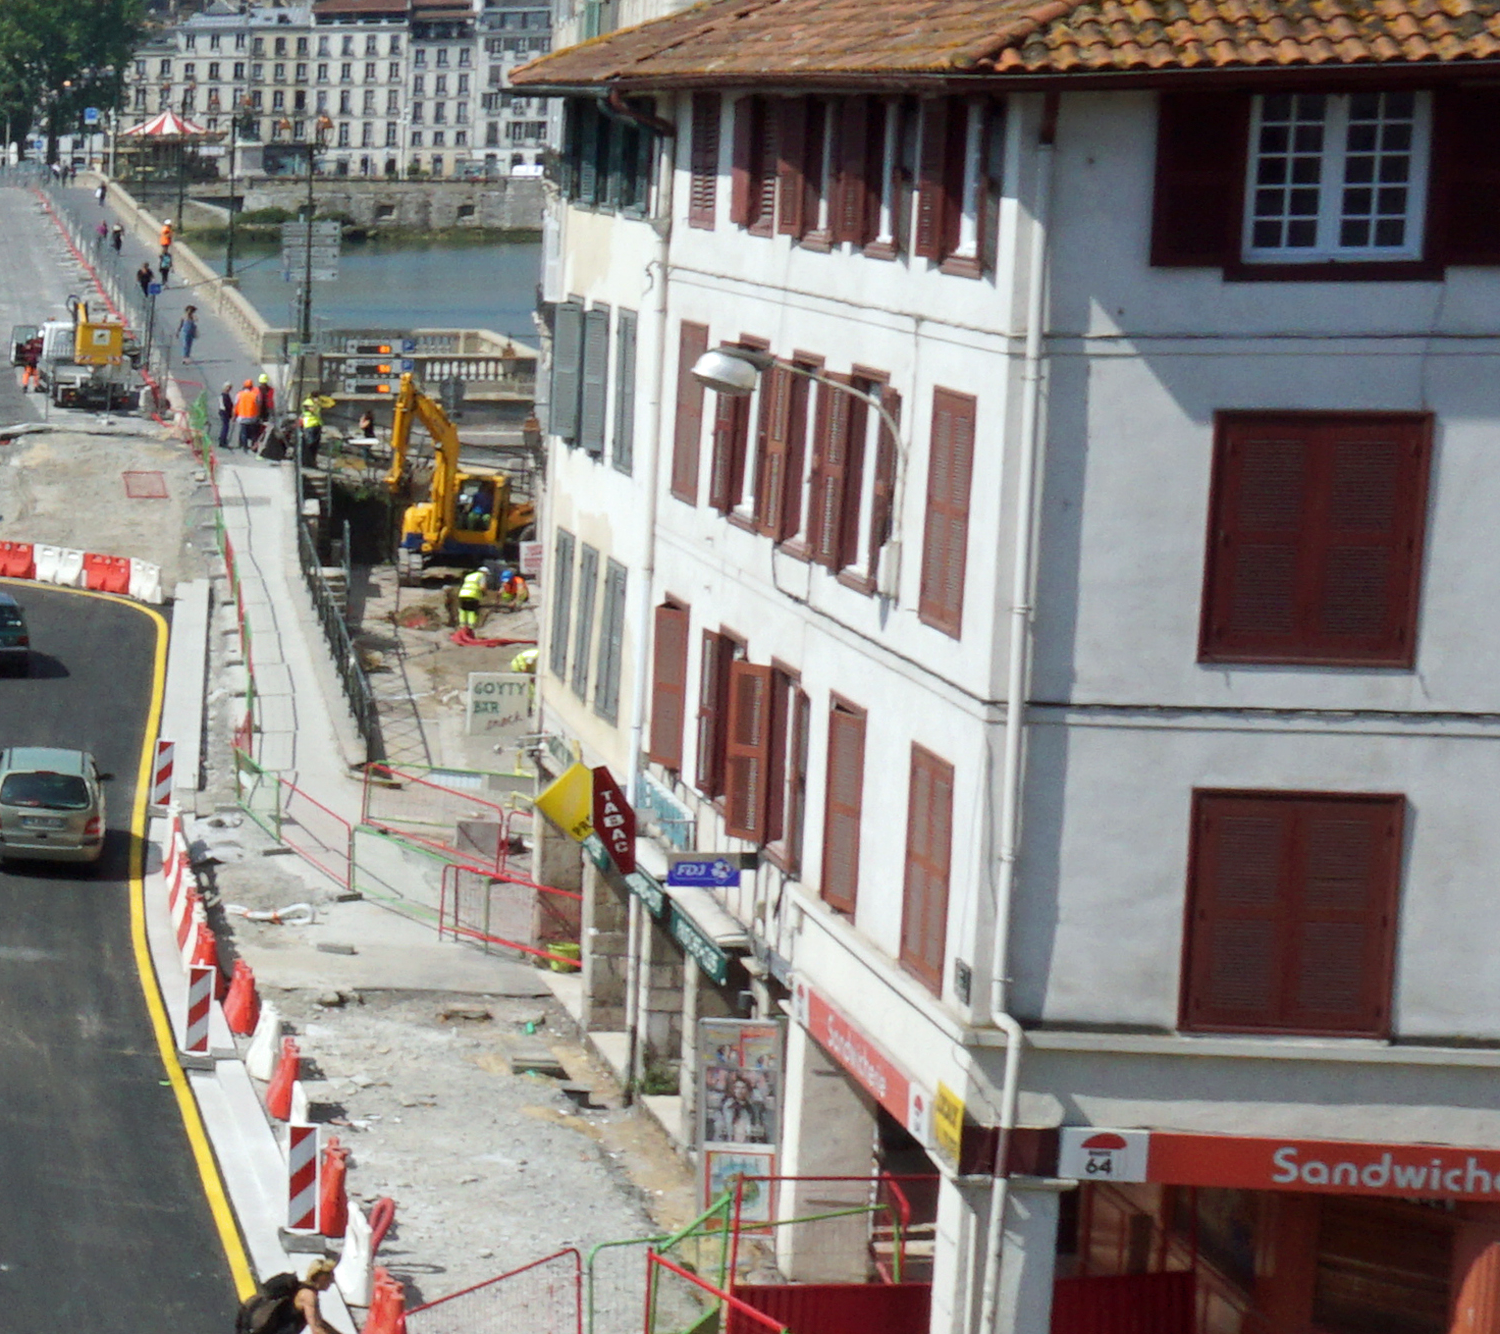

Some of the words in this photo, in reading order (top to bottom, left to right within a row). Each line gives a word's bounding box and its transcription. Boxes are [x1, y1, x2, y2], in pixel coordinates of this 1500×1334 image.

[474, 682, 526, 695] GOYTY
[473, 701, 499, 714] BAR
[600, 790, 629, 854] TABAC
[675, 863, 707, 876] FDJ
[1085, 1158, 1112, 1175] 64
[1271, 1146, 1500, 1194] Sandwich
